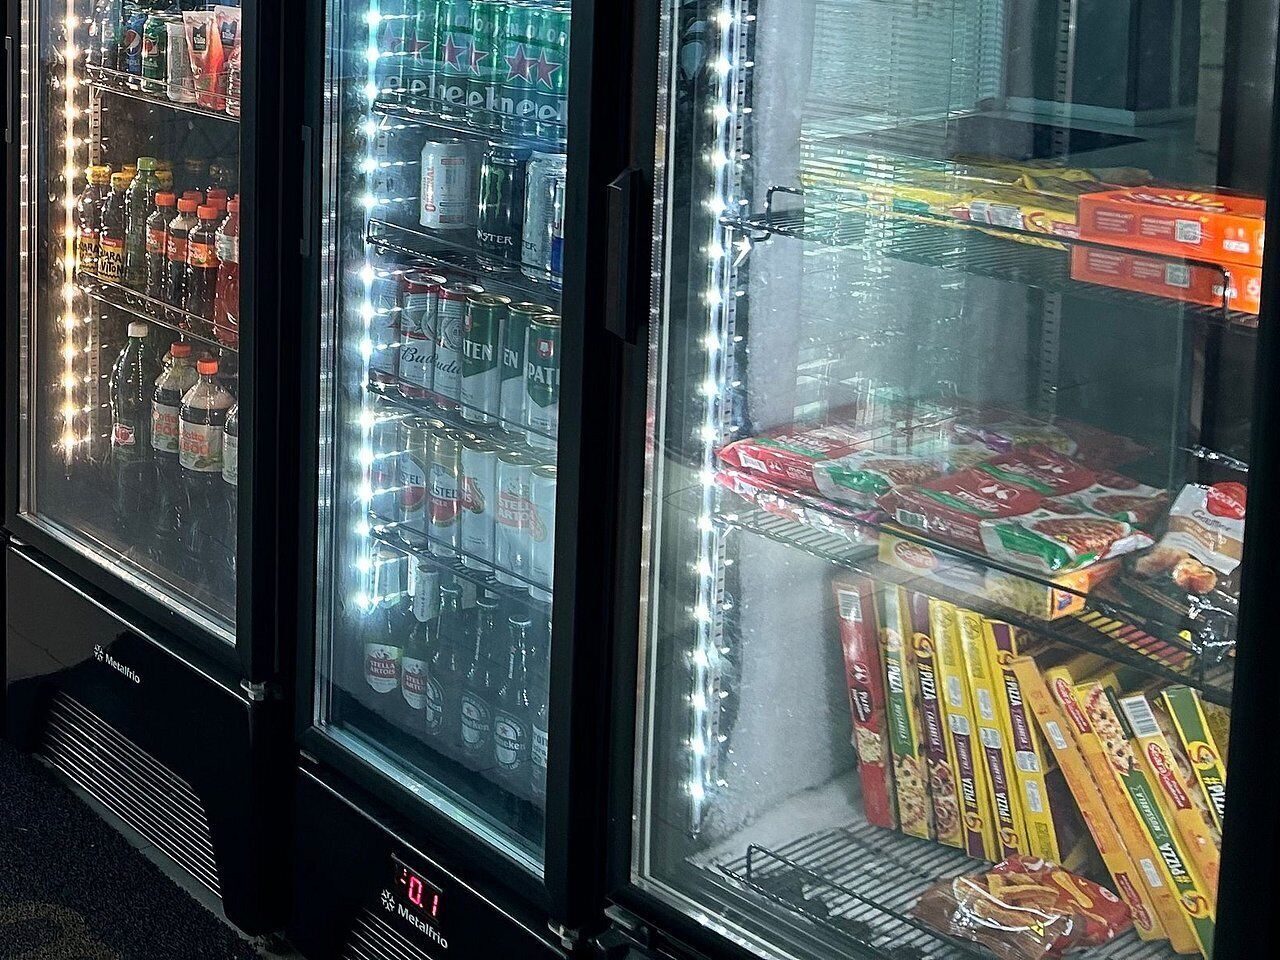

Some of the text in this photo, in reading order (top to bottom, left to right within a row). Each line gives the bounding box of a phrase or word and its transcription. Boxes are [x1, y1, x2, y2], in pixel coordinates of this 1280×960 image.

[105, 653, 141, 685] Metalfrio
[886, 657, 904, 694] #PIZZA
[918, 661, 937, 700] #PIZZA
[1004, 674, 1023, 707] #PIZZA
[991, 790, 1013, 829] #PIZZA
[1158, 840, 1190, 885] #PIZZA
[398, 903, 449, 949] Metalfrio
